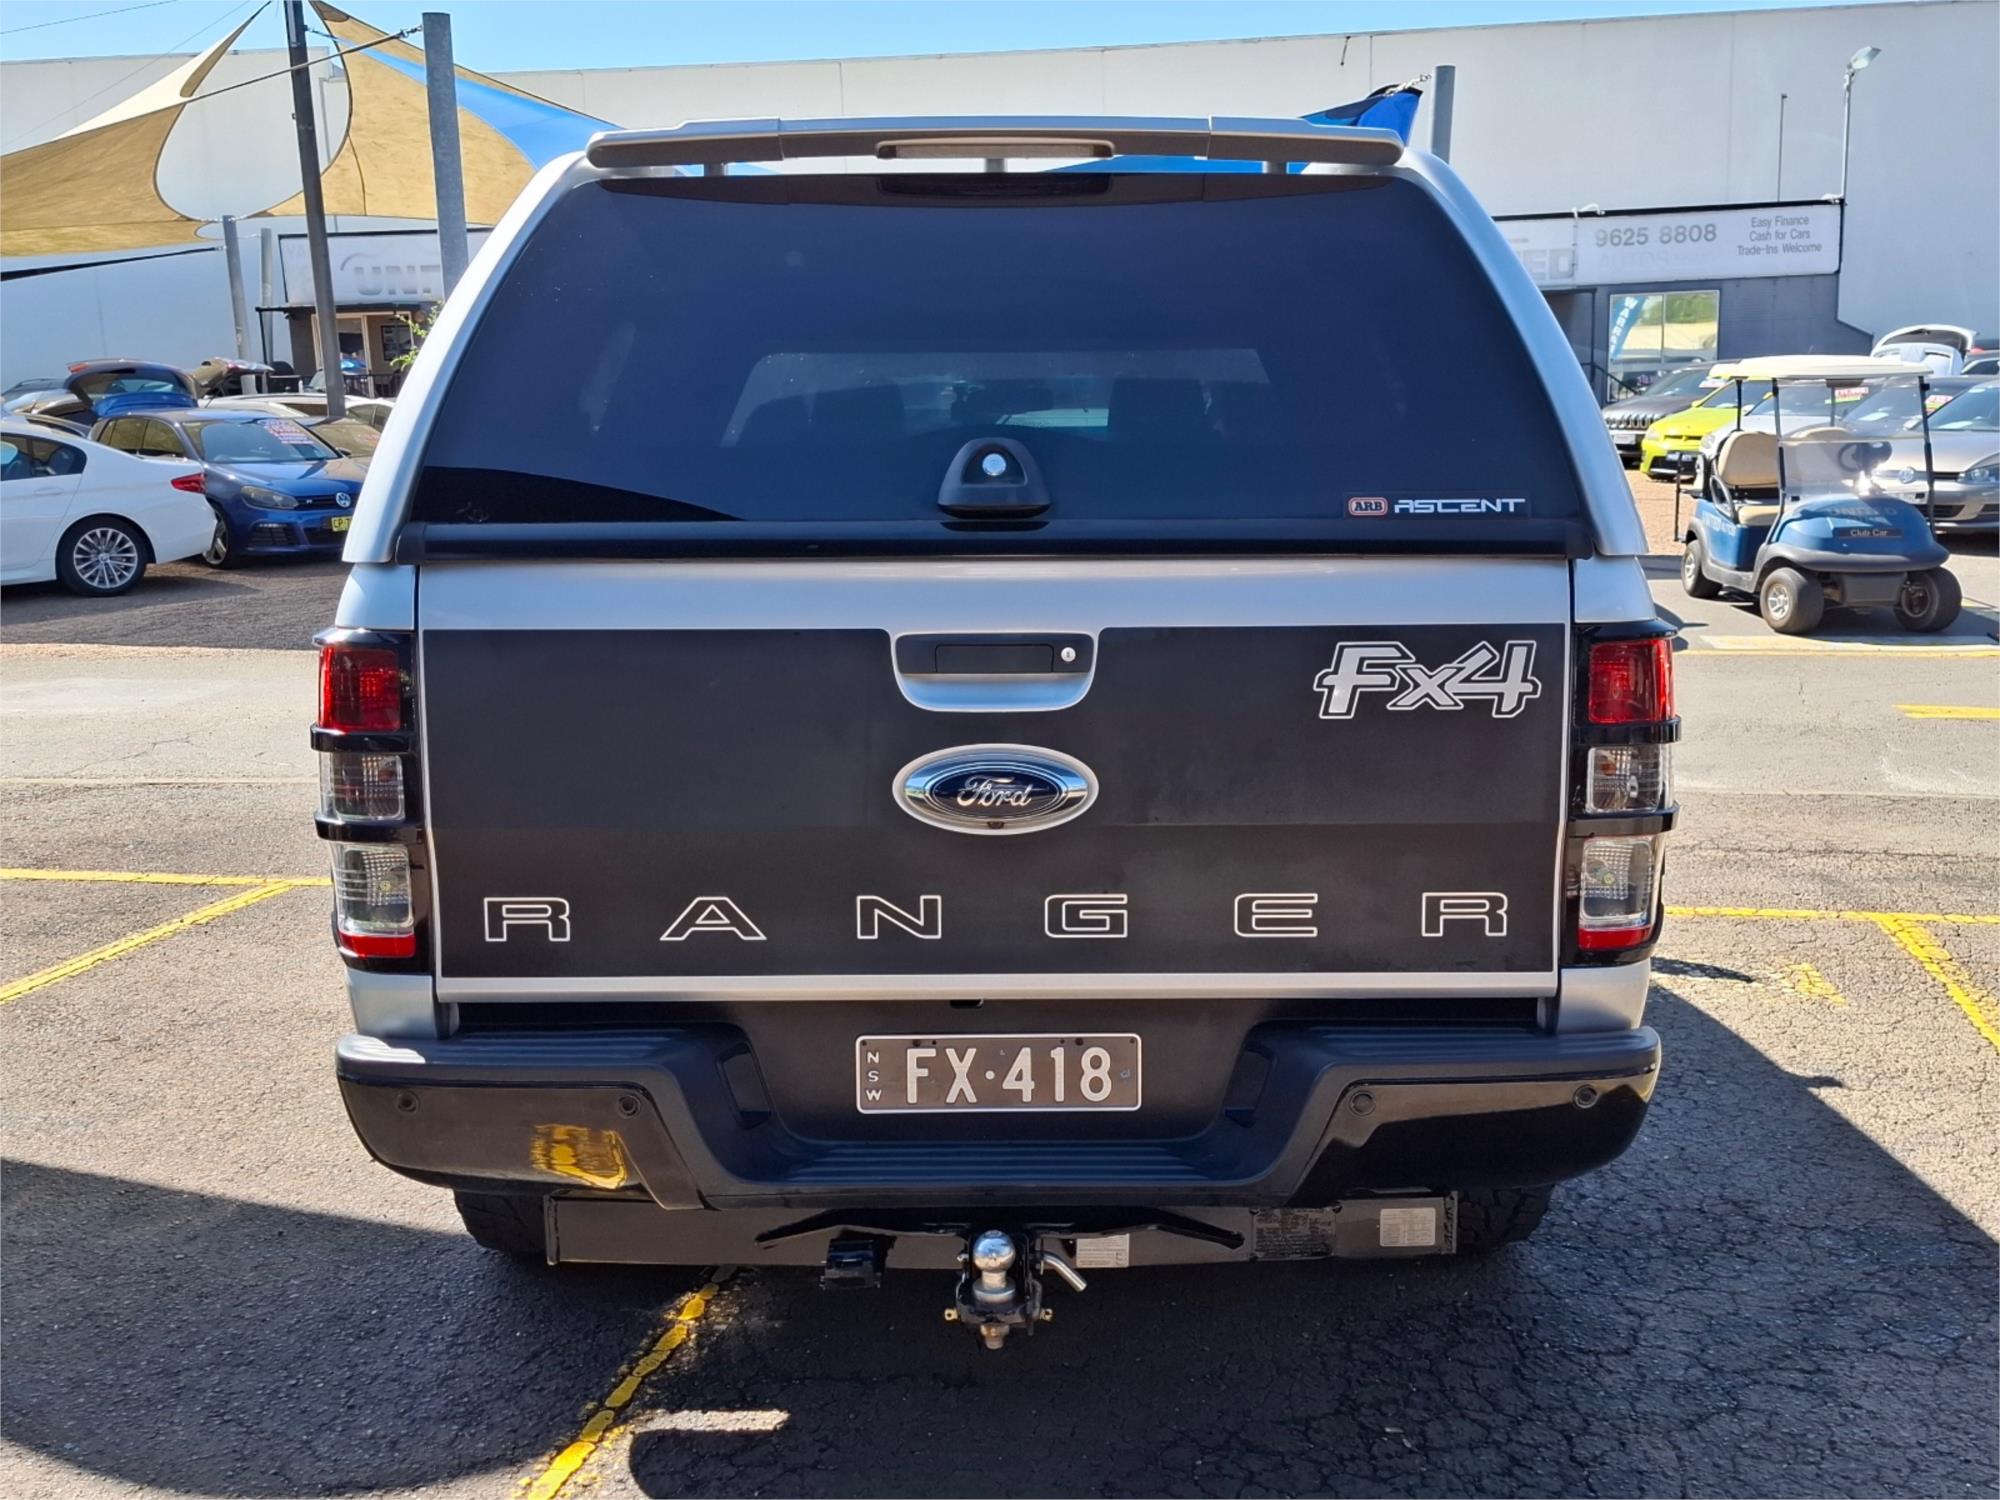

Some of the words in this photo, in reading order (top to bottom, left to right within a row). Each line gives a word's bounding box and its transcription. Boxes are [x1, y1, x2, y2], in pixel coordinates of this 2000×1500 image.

[1751, 217, 1772, 229] Easy
[1775, 215, 1810, 227] Finance
[1596, 227, 1649, 247] 9625
[1659, 223, 1717, 244] 8808
[1749, 230, 1771, 241] Cash
[1775, 230, 1787, 240] for
[1790, 228, 1811, 239] Cars
[1736, 244, 1778, 255] Trade-Ins
[1782, 242, 1823, 253] Welcome
[1394, 498, 1526, 513] ASCENT
[1849, 528, 1870, 537] Club
[1872, 528, 1888, 537] Car
[956, 775, 1032, 807] Ford
[483, 892, 1508, 942] RANGER
